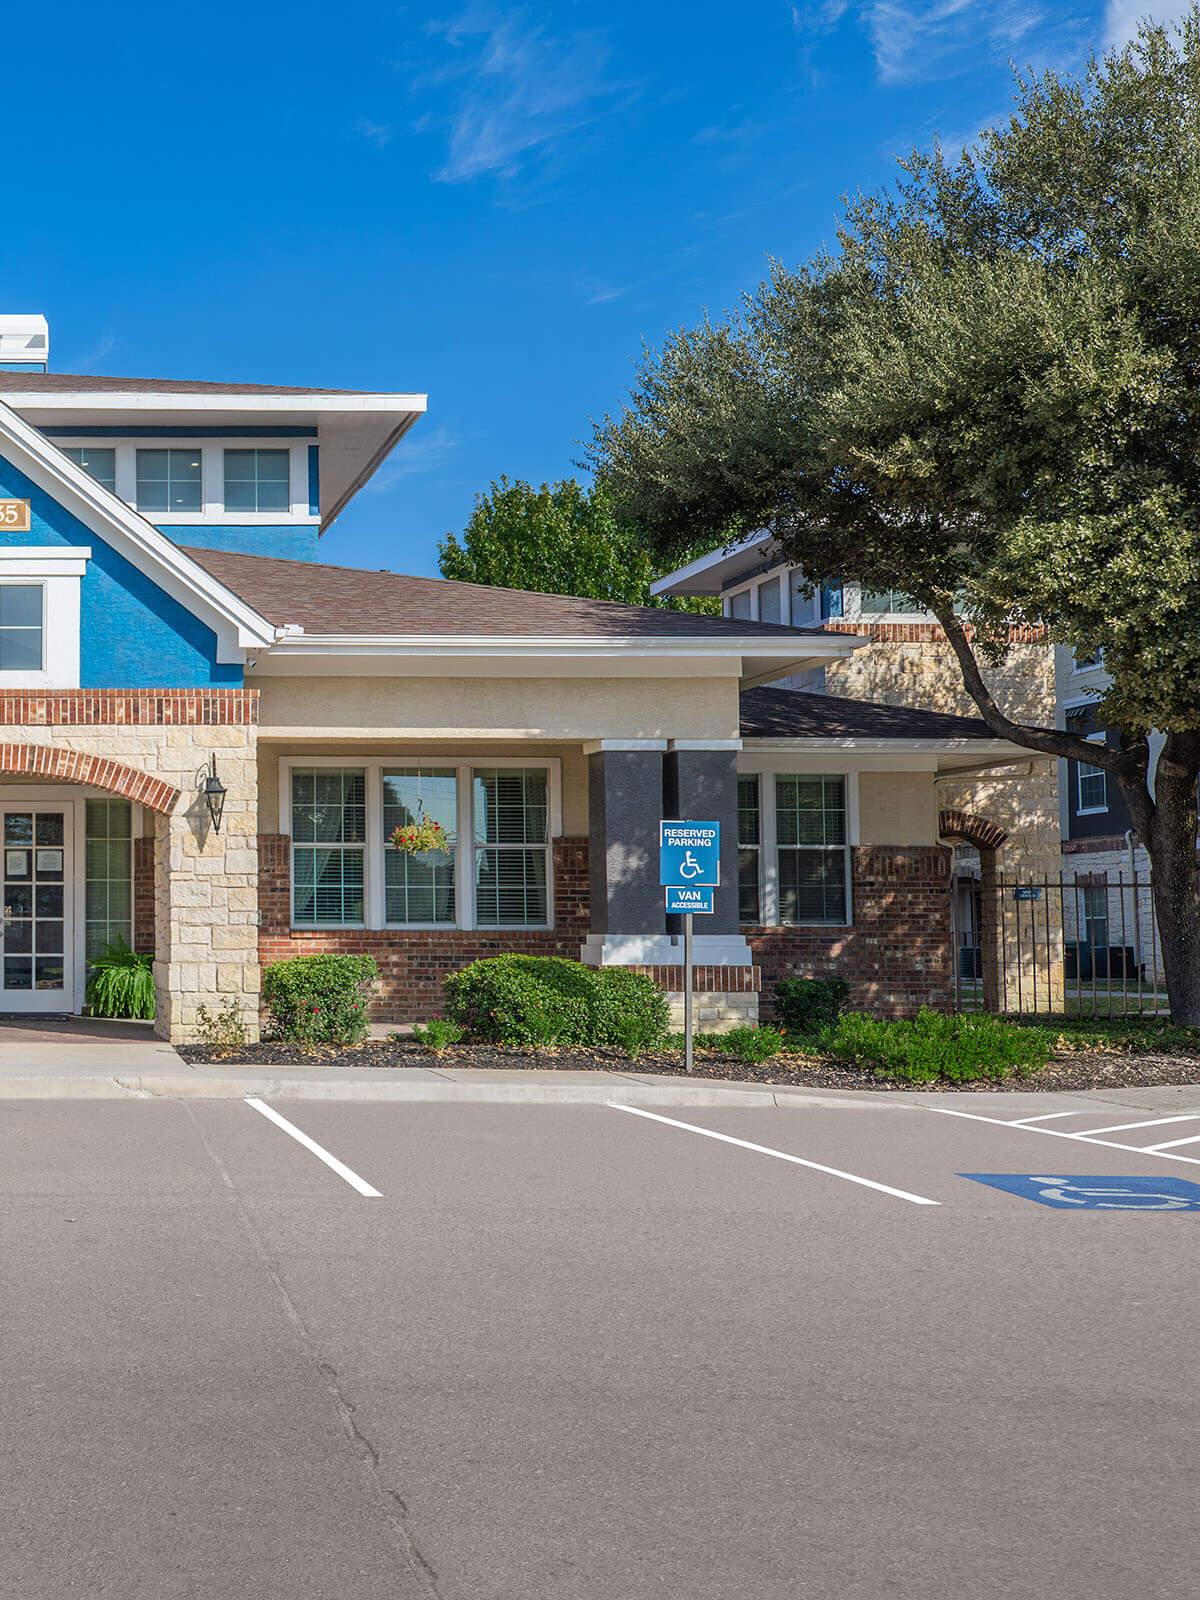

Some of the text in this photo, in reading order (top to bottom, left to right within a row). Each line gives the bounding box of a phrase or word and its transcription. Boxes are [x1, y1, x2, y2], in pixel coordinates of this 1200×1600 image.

[664, 828, 716, 838] RESERVED
[668, 838, 712, 847] PARKING
[678, 891, 701, 901] VAN
[671, 901, 709, 909] ACCESSIBLE
